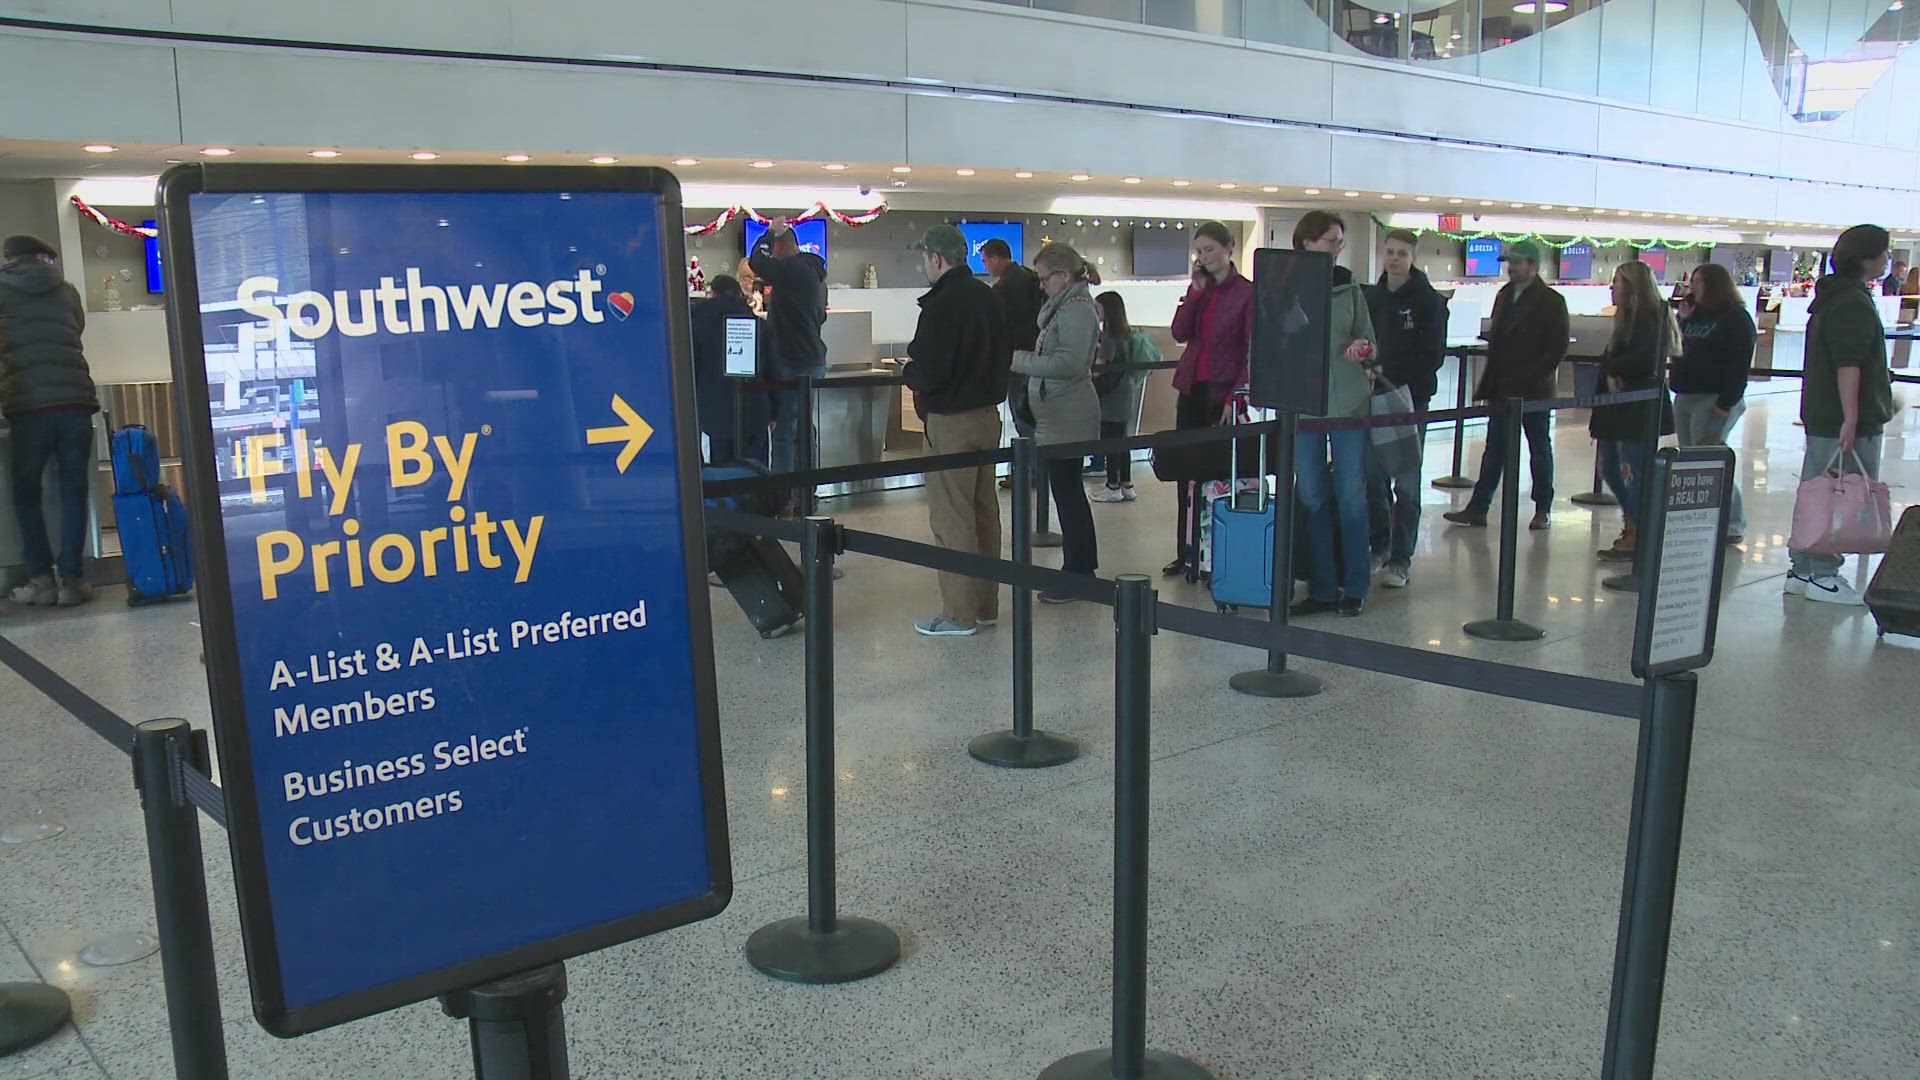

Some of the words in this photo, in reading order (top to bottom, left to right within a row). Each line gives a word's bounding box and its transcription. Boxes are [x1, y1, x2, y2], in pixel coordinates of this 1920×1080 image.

[1474, 244, 1493, 252] DELTA
[1568, 247, 1585, 255] DELTA
[246, 428, 361, 515] Fly
[1671, 474, 1681, 488] Do
[1682, 476, 1696, 490] you
[1697, 473, 1714, 486] have
[1668, 495, 1674, 506] a
[1675, 491, 1695, 505] REAL
[1696, 490, 1710, 504] ID?
[255, 505, 544, 600] Priority
[269, 648, 368, 691] A-List
[375, 642, 401, 672] &
[409, 627, 499, 667] A-List
[511, 599, 648, 649] Preferred
[273, 686, 436, 738] Members
[283, 750, 426, 802] Business
[288, 788, 463, 847] Customers
